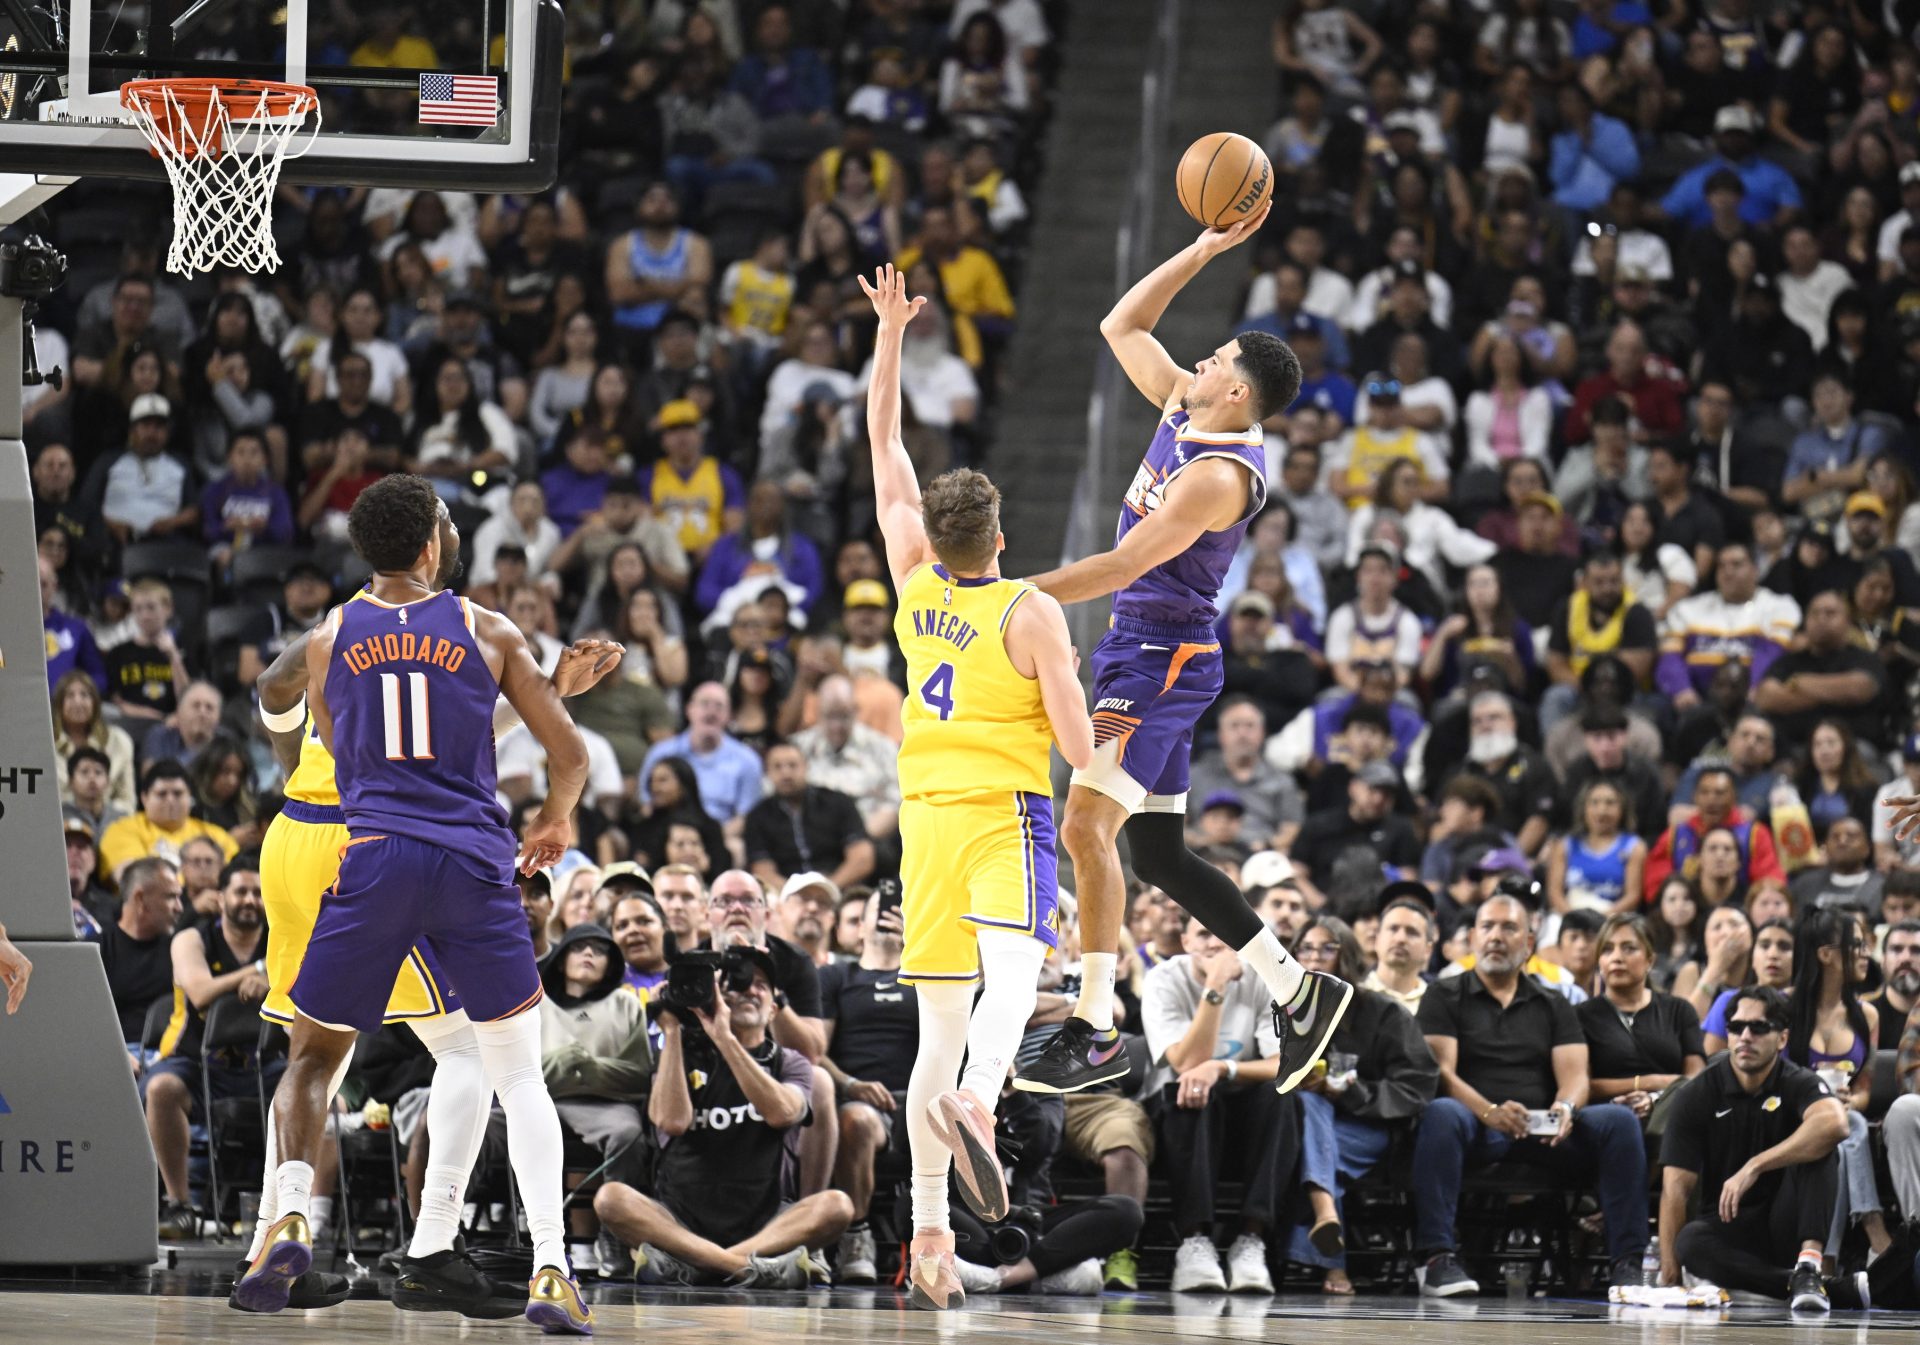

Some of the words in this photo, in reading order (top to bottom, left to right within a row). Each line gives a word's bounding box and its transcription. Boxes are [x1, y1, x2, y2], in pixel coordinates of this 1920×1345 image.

[1233, 159, 1269, 214] Wilson
[342, 632, 467, 676] IGHODARO
[912, 609, 979, 652] KNECHT
[379, 671, 437, 761] 11
[919, 660, 955, 721] 4
